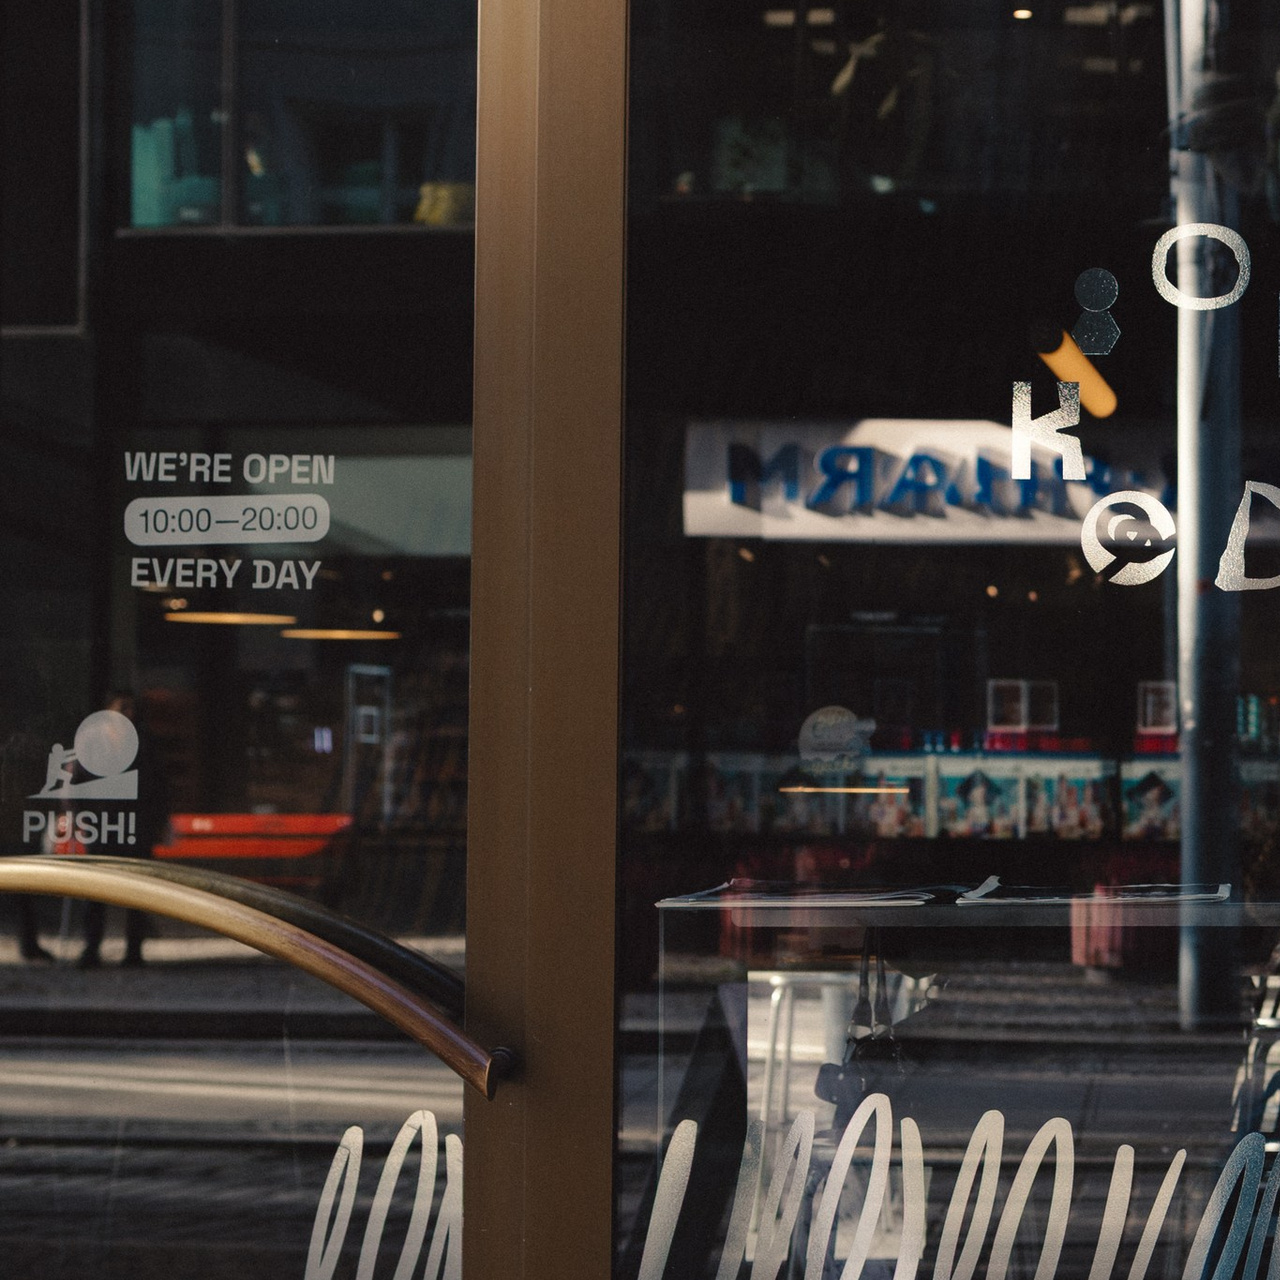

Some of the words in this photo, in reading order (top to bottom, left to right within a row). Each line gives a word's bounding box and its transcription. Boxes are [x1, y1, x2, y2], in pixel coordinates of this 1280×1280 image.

[124, 451, 232, 482] WE’RE
[243, 453, 335, 484] OPEN
[131, 557, 242, 588] EVERY
[252, 559, 321, 590] DAY
[23, 810, 136, 845] PUSH!
